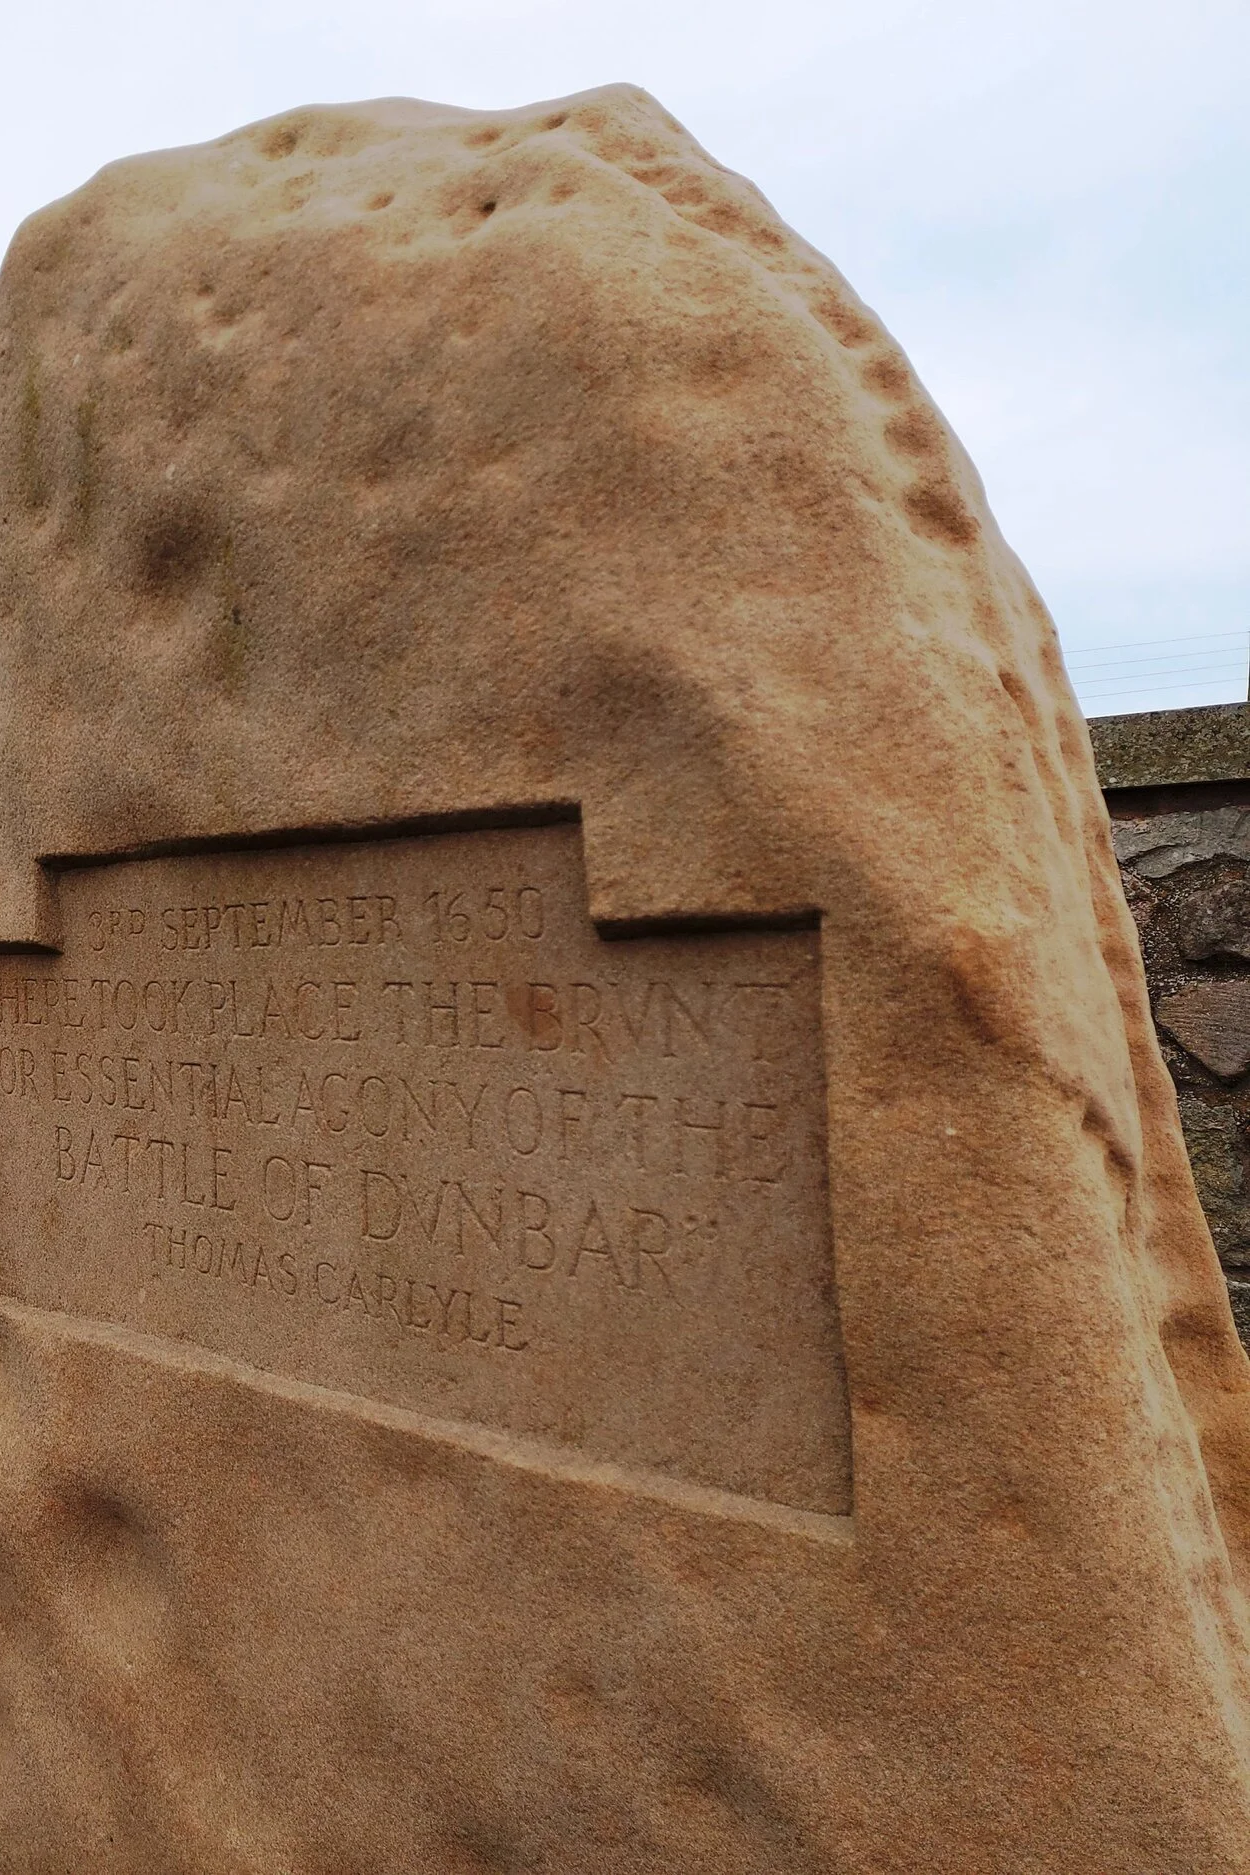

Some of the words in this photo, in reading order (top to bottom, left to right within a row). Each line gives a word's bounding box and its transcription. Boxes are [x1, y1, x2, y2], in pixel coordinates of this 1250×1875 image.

[88, 908, 146, 951] 3RD
[162, 896, 403, 951] SEPTEMBER
[424, 886, 547, 943] 1650
[90, 979, 198, 1034] TOOK
[205, 980, 362, 1042] PLACE
[382, 981, 506, 1048] THE
[52, 1050, 280, 1127] ESSENTIAL
[291, 1070, 488, 1151] AGONY
[506, 1087, 587, 1162] OF
[616, 1092, 789, 1184] THE
[55, 1125, 236, 1211] BATTLE
[263, 1156, 333, 1226] OF
[144, 1221, 299, 1296] THOMAS
[313, 1261, 529, 1351] CARLYLE
